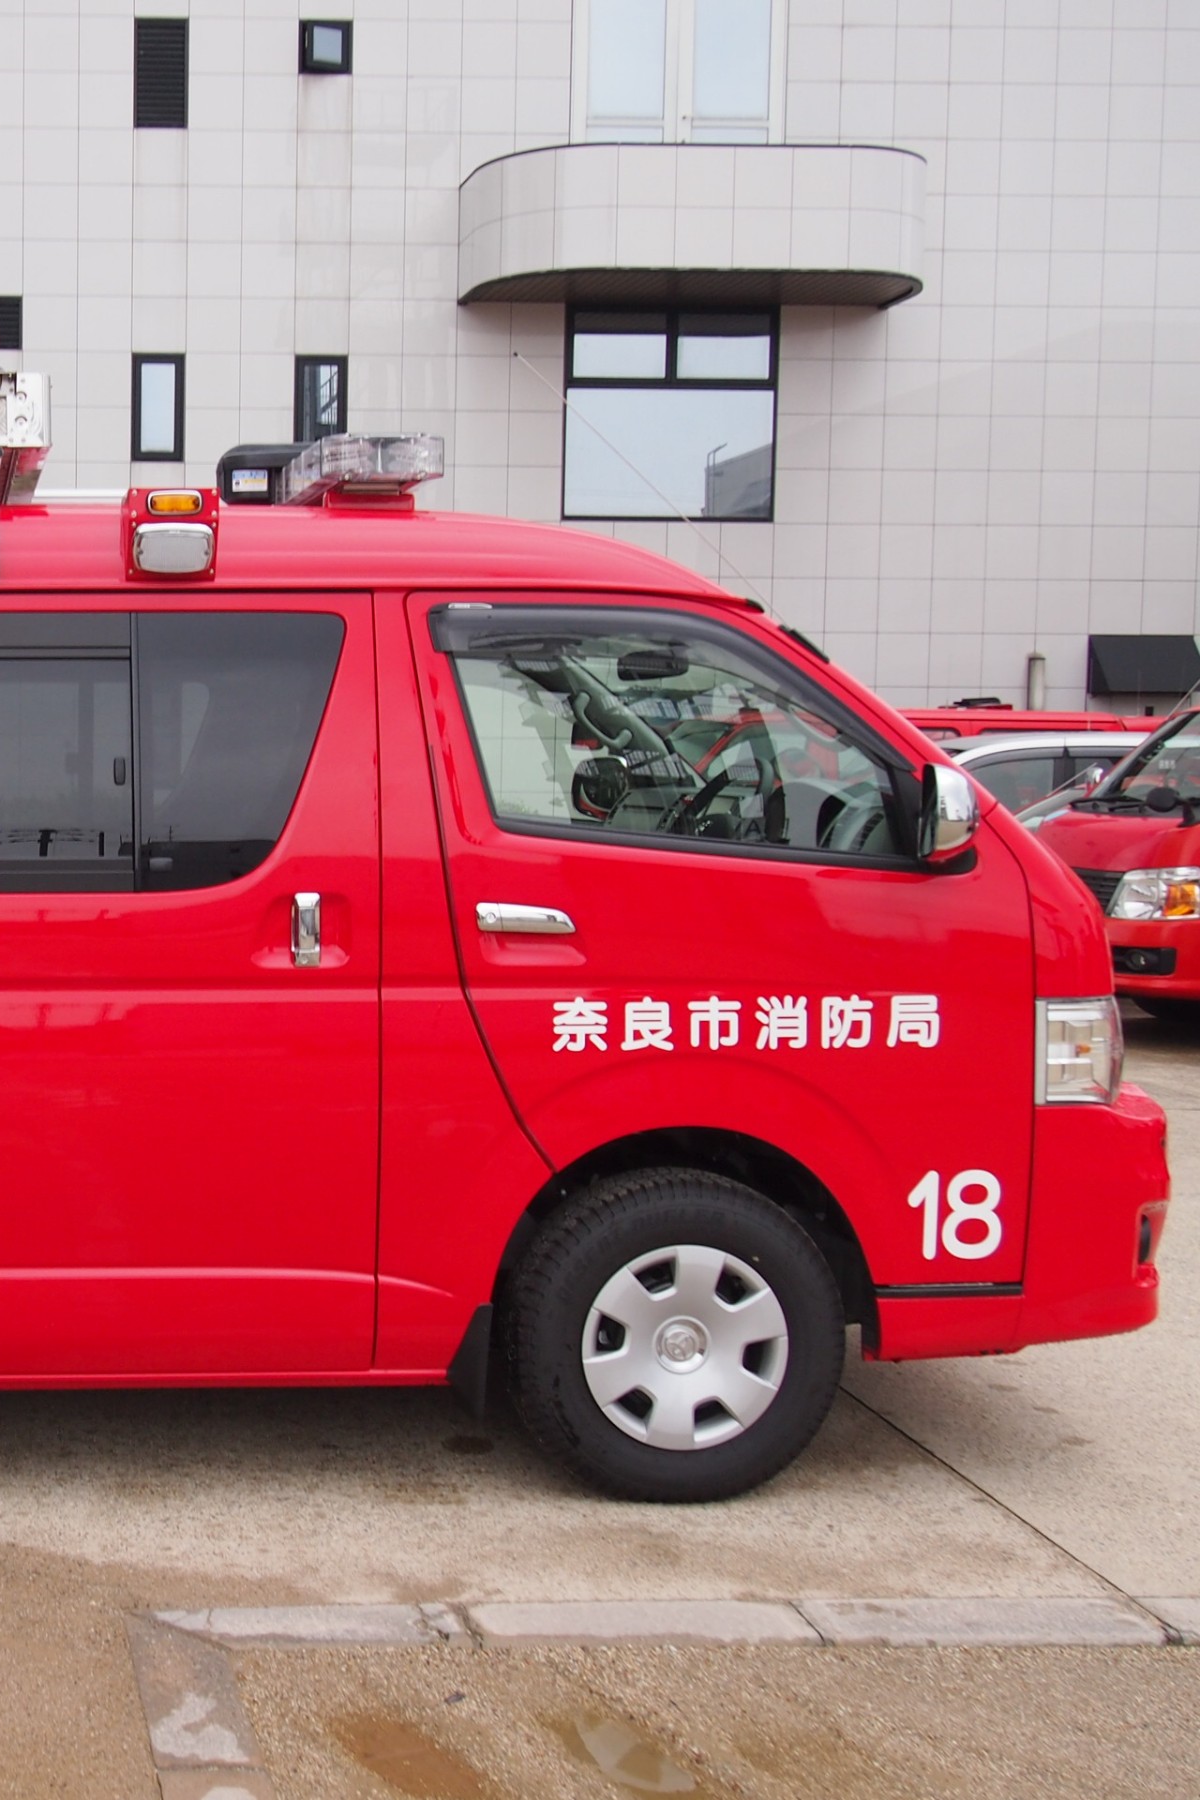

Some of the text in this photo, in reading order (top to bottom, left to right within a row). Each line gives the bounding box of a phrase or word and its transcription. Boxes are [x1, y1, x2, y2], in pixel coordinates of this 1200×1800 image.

[552, 994, 940, 1052] 奈良市消防局
[907, 1169, 1001, 1260] 18
